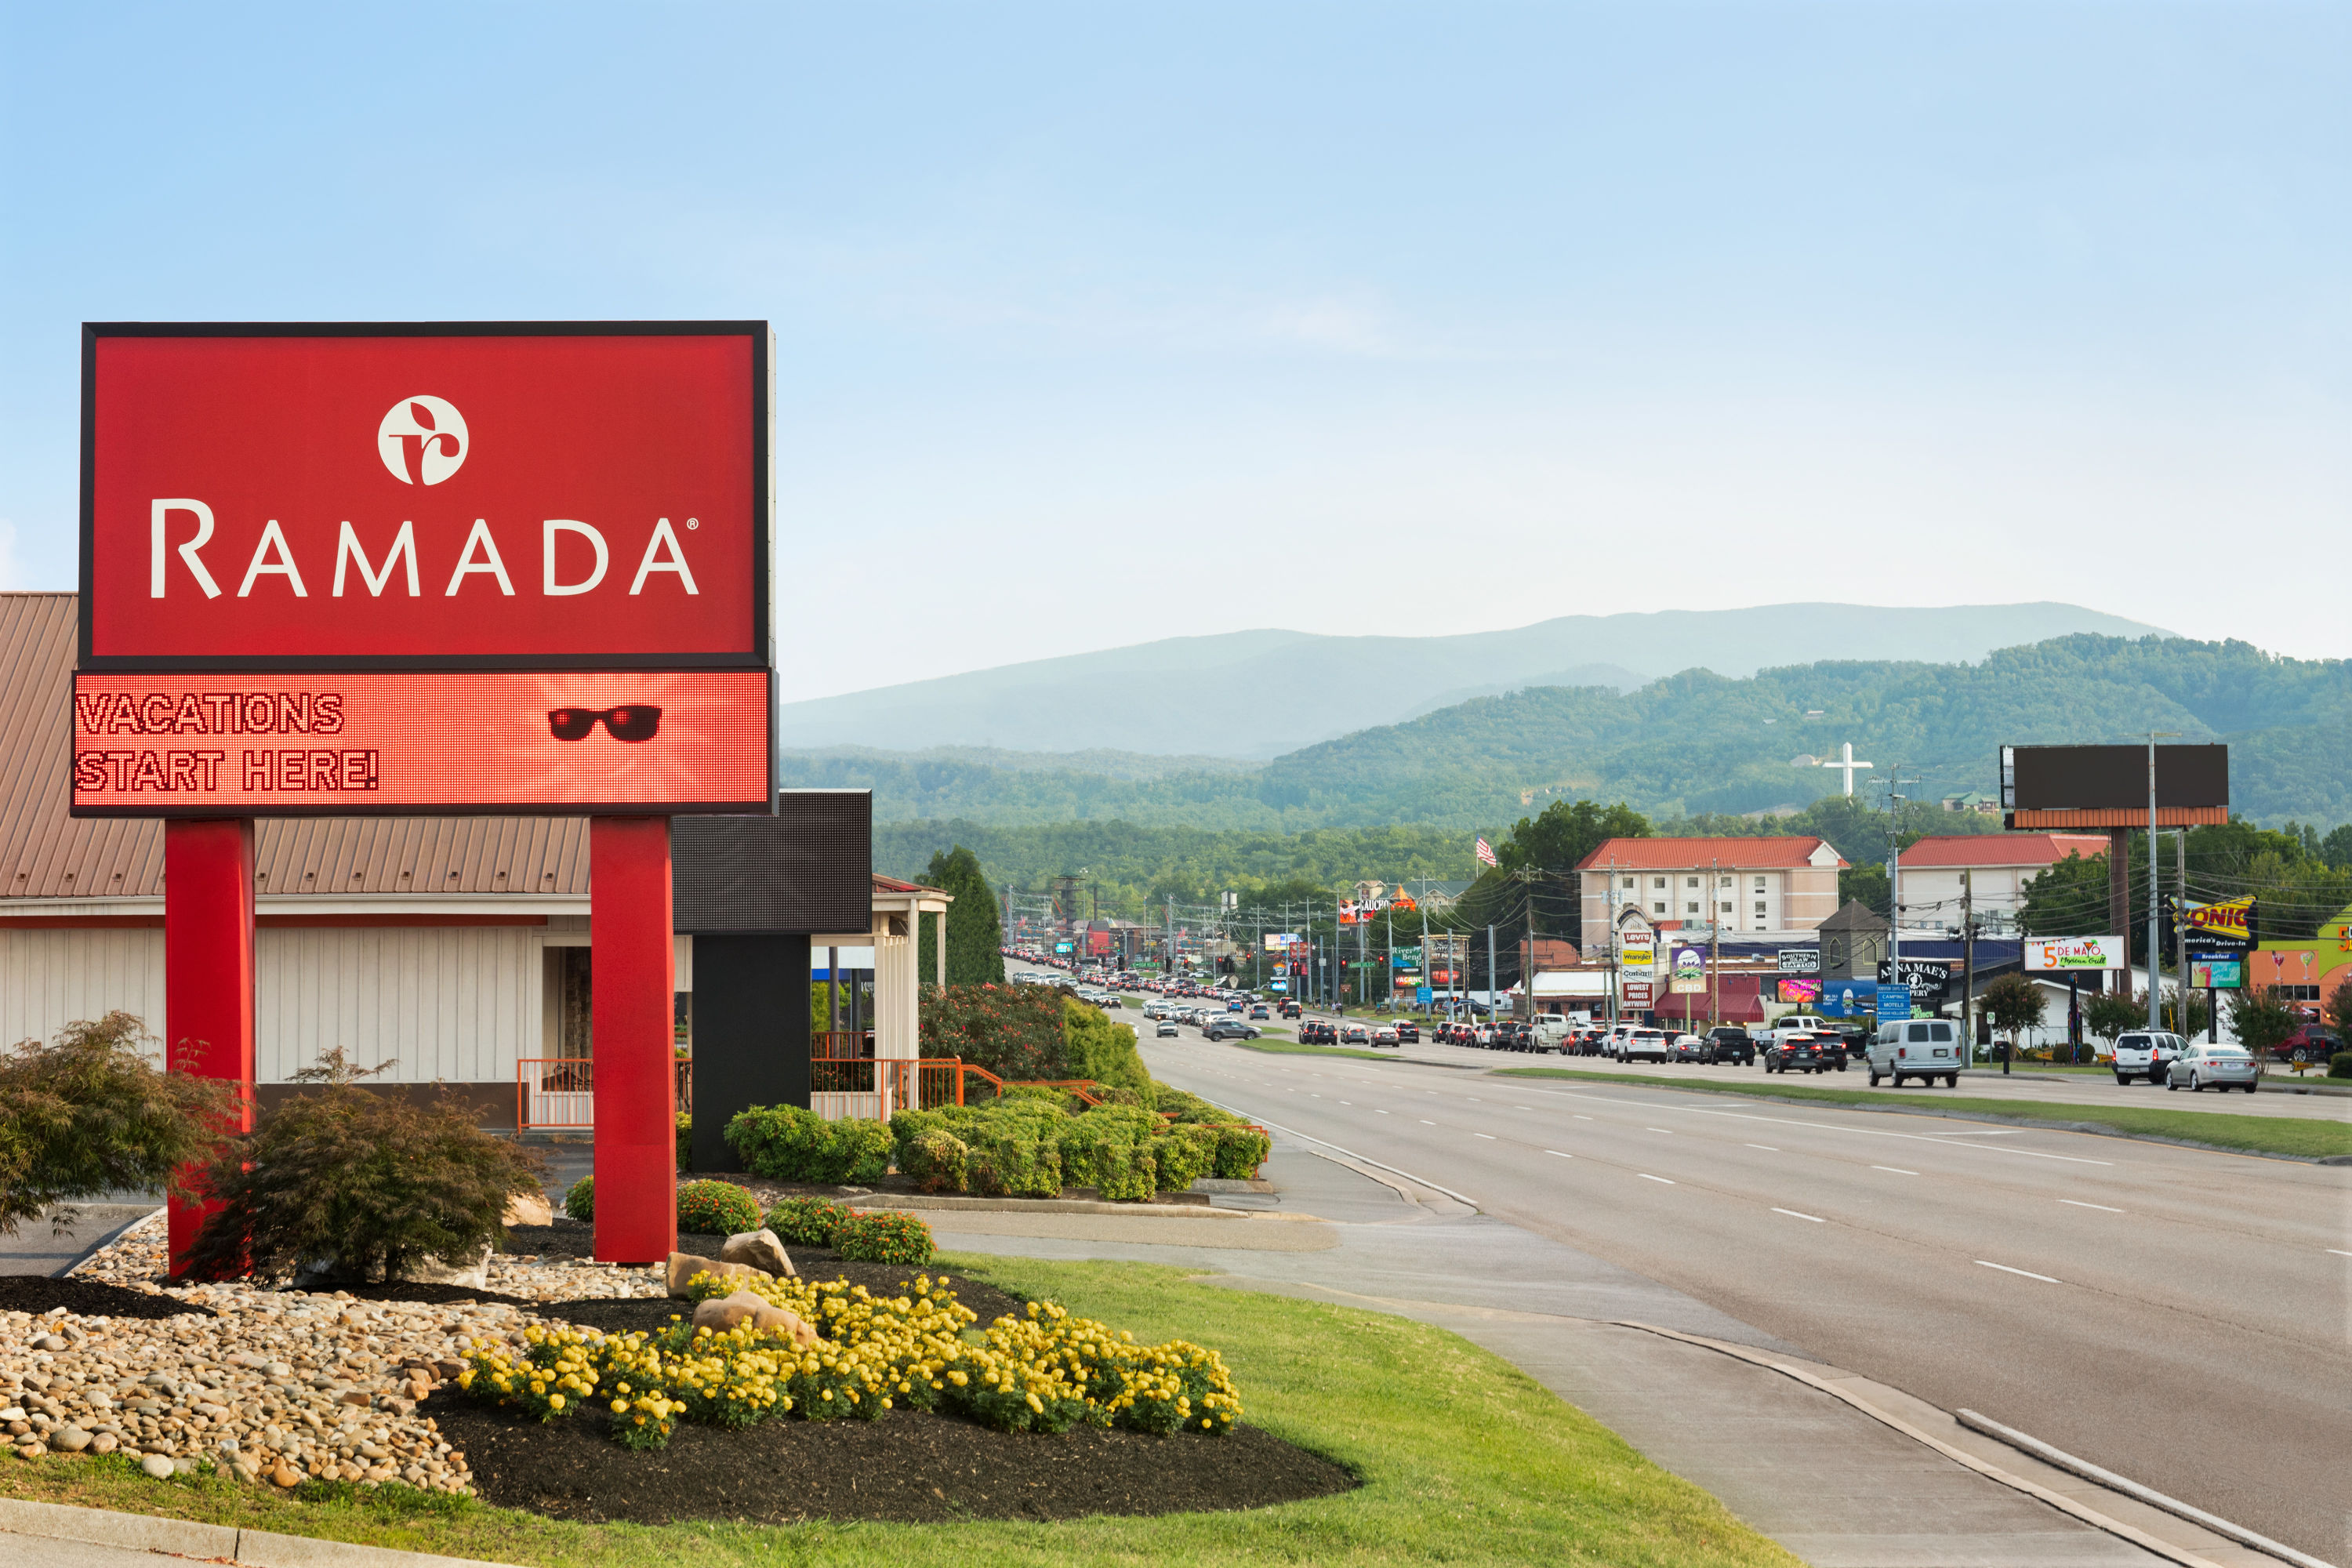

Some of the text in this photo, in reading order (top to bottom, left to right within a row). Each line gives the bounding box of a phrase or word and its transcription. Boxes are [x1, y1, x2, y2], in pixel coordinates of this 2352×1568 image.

[77, 692, 343, 734] VACATIONS
[77, 750, 379, 791] START HERE!
[2185, 908, 2249, 927] ONIC
[2339, 926, 2350, 952] 5
[2044, 942, 2101, 968] 5 DE MAYO
[2088, 956, 2107, 964] Grill
[1914, 963, 1948, 979] MAE'S
